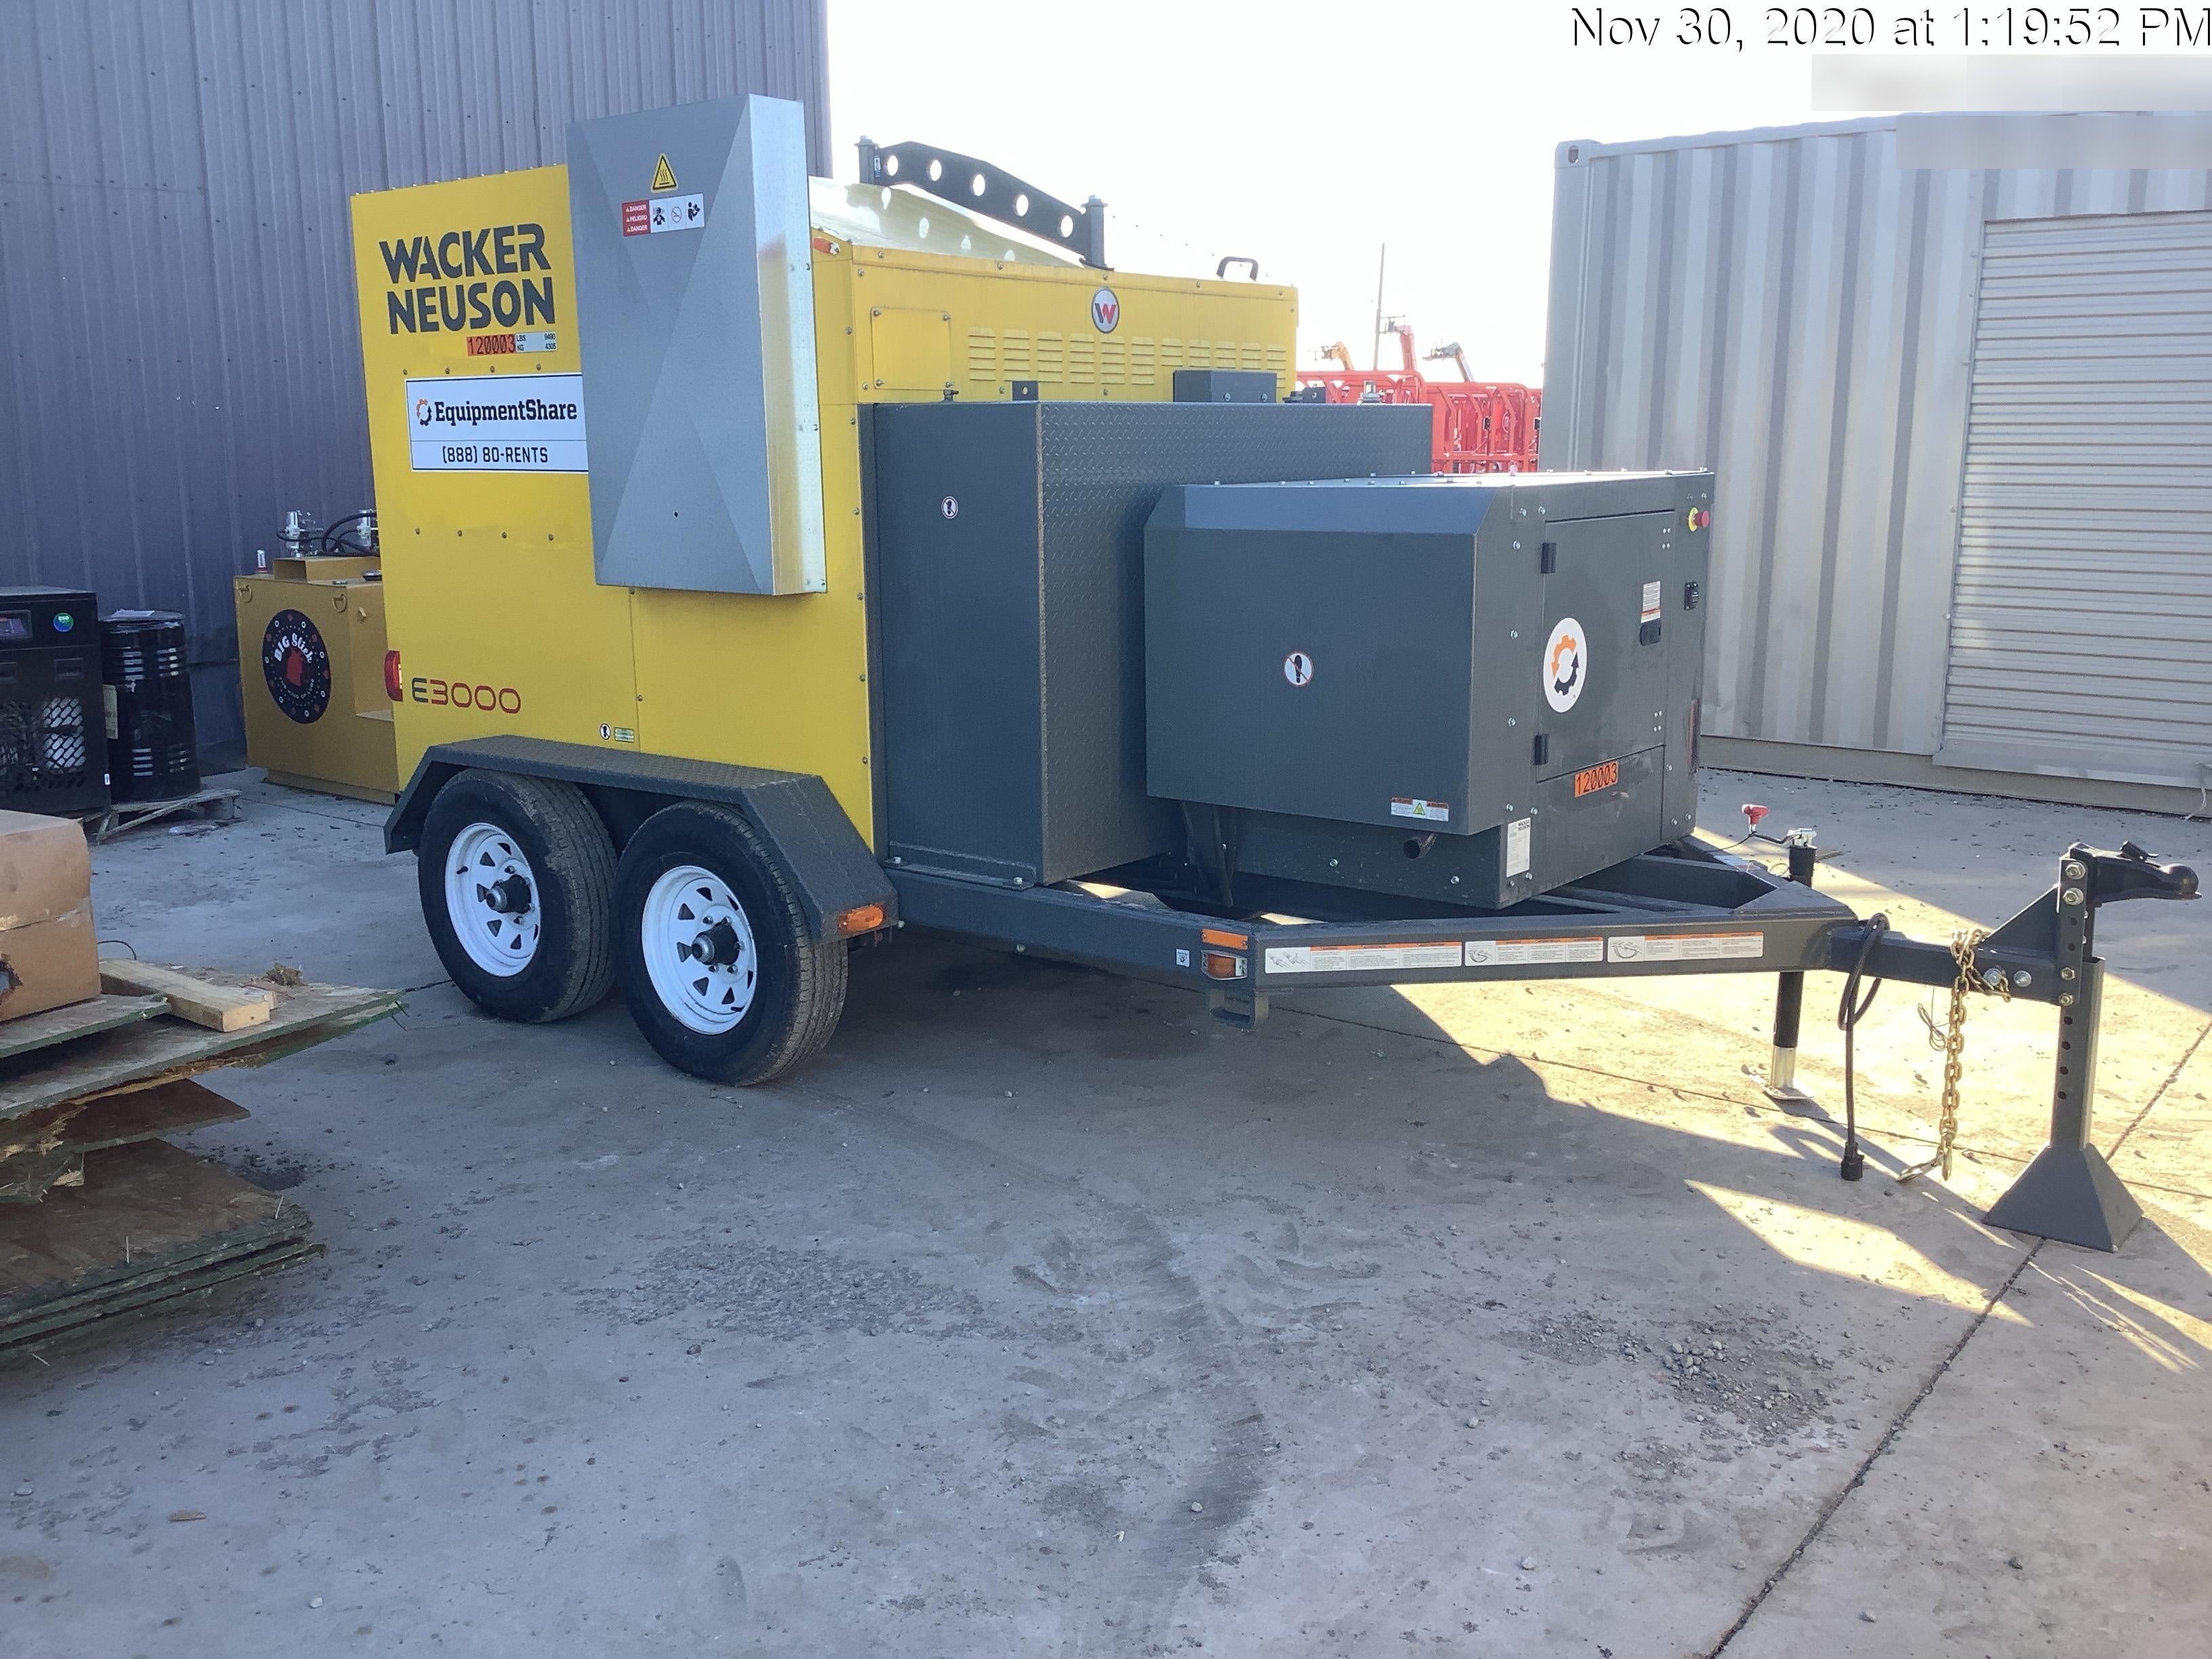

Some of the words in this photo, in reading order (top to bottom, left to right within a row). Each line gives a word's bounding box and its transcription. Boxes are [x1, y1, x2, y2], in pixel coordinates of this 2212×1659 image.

[629, 204, 647, 212] DANGER
[379, 223, 552, 283] WACKER
[387, 276, 556, 334] NEUSON
[468, 334, 516, 354] 120003
[434, 398, 577, 426] EquipmentShare
[442, 446, 478, 464] (888)
[483, 446, 548, 464] 80-RENTS
[274, 635, 290, 662] BIG
[291, 632, 313, 664] Slick
[411, 677, 522, 714] E3000
[1576, 762, 1618, 795] 120003
